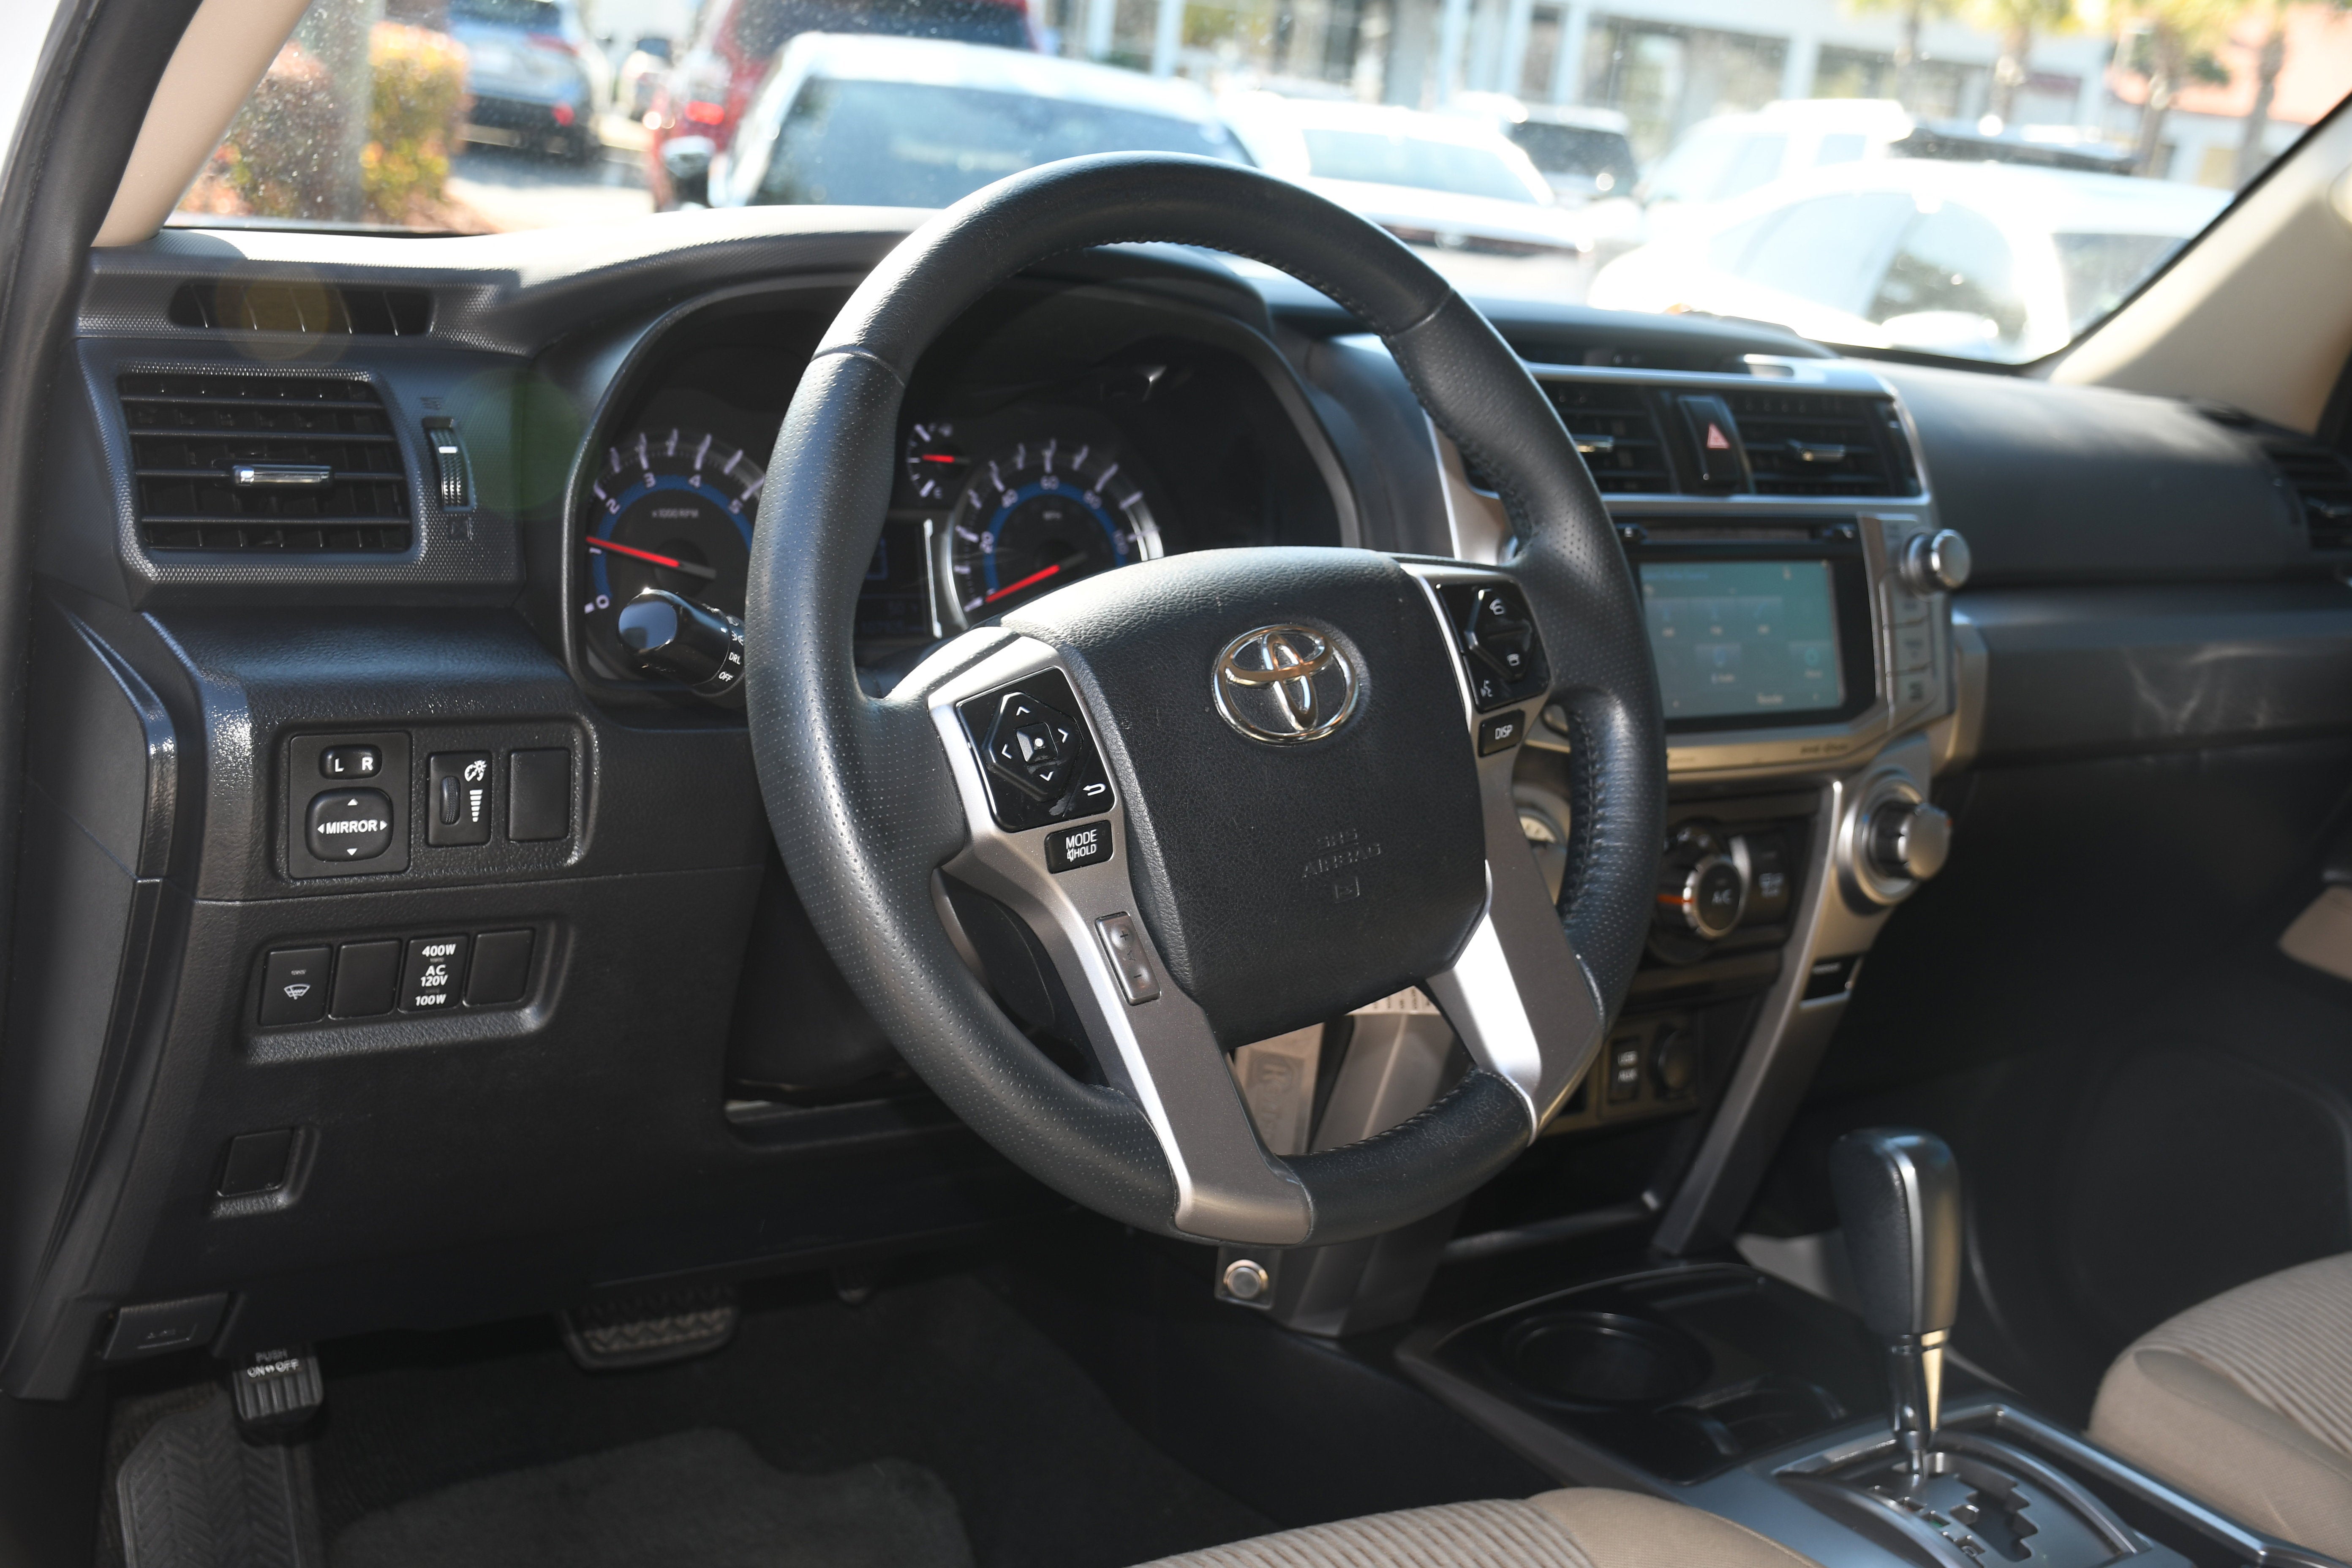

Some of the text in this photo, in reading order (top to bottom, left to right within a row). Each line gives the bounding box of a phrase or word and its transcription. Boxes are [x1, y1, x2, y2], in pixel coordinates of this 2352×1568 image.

[643, 472, 656, 488] 3
[688, 474, 702, 488] 4
[606, 498, 621, 515] 2
[596, 594, 610, 609] 0
[729, 652, 740, 665] DRL
[719, 671, 733, 682] OFF
[1495, 724, 1513, 740] DISP
[335, 758, 344, 772] L
[362, 757, 373, 771] R
[326, 819, 378, 834] MIRROR
[1066, 829, 1098, 849] MODE
[1074, 844, 1097, 858] HOLD
[422, 944, 457, 957] 400W
[425, 964, 446, 976] AC
[420, 974, 449, 987] 120V
[415, 994, 446, 1006] 100W
[275, 1358, 299, 1373] OFF
